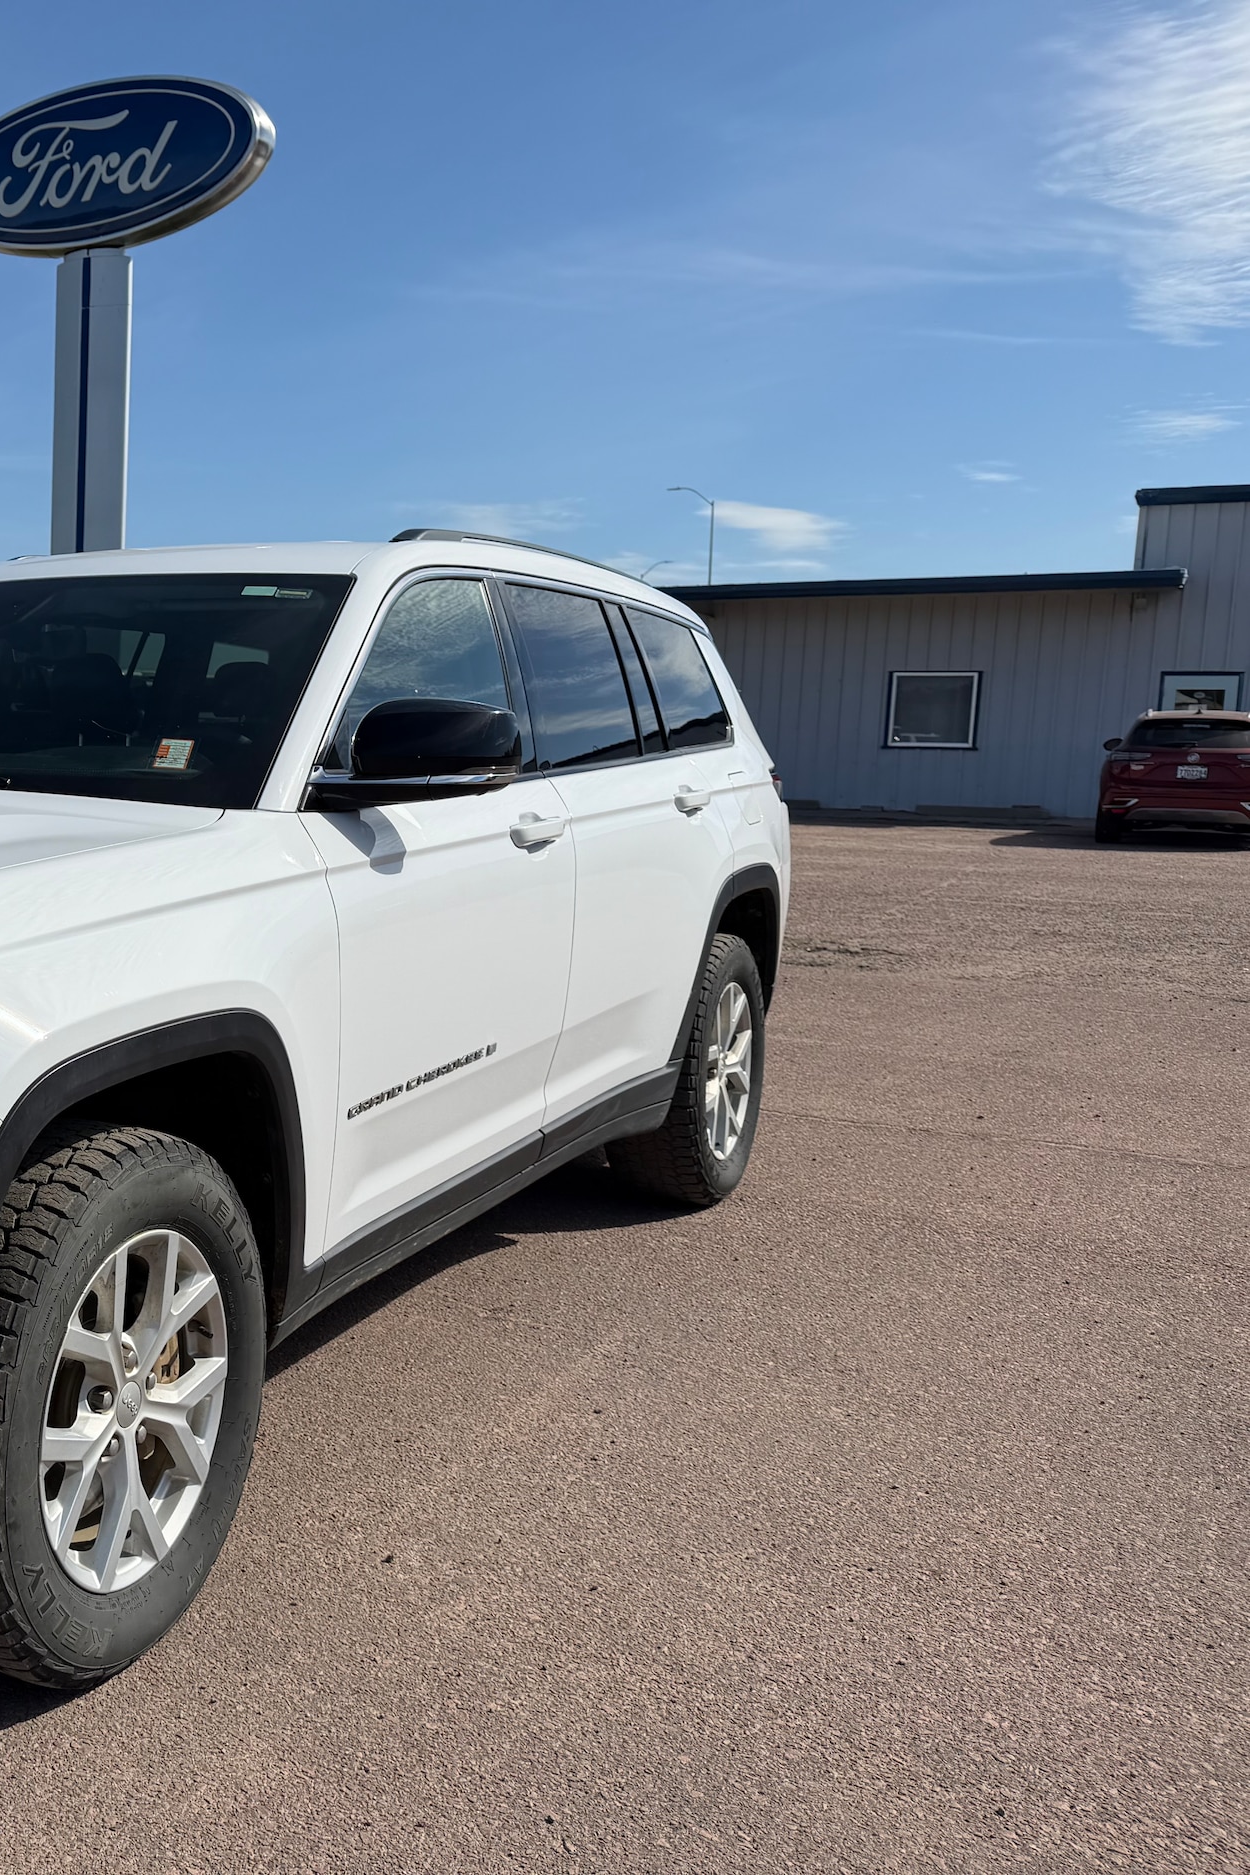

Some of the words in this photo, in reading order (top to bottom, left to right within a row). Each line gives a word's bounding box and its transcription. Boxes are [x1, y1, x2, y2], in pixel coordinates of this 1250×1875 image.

[347, 1083, 404, 1120] GRAND
[405, 1047, 485, 1092] CHEROKEE
[190, 1181, 259, 1286] KELLY
[122, 1393, 138, 1417] Jeep
[21, 1562, 113, 1659] KELLY
